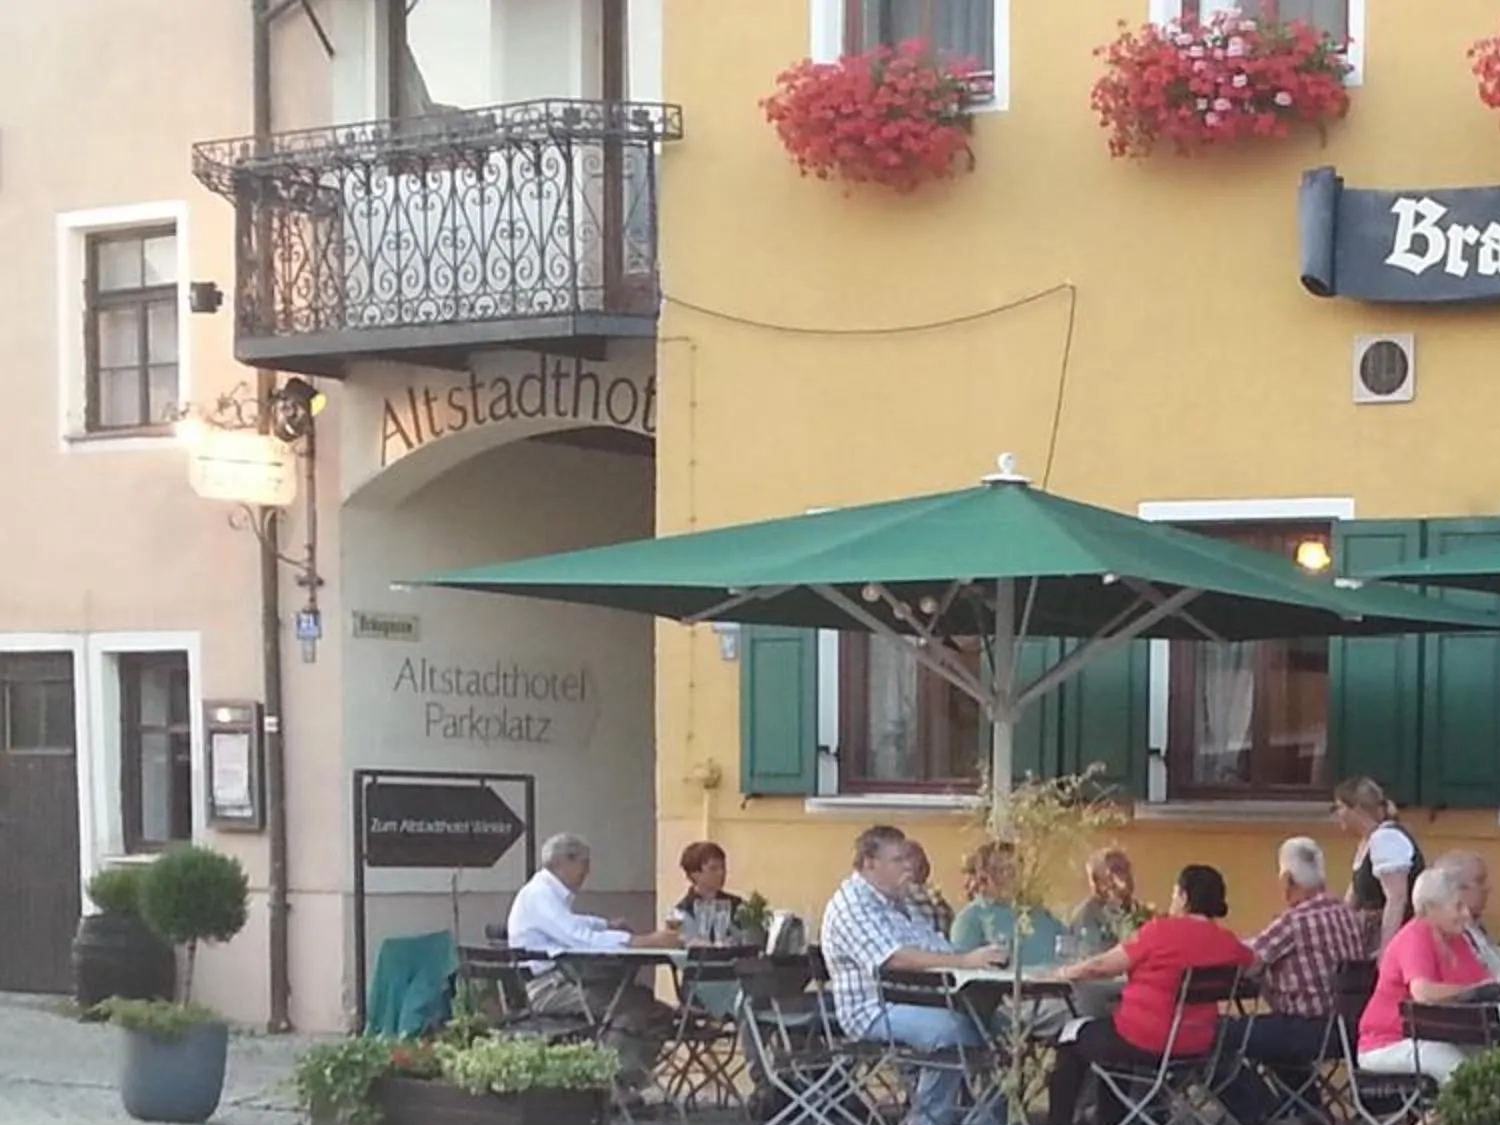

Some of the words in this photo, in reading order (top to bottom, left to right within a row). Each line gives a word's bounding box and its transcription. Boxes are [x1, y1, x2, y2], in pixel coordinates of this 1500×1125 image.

[393, 656, 586, 702] Altstadthotel
[425, 702, 552, 747] Parkplatz
[371, 817, 397, 833] Zum
[400, 817, 469, 833] Altstadthotel
